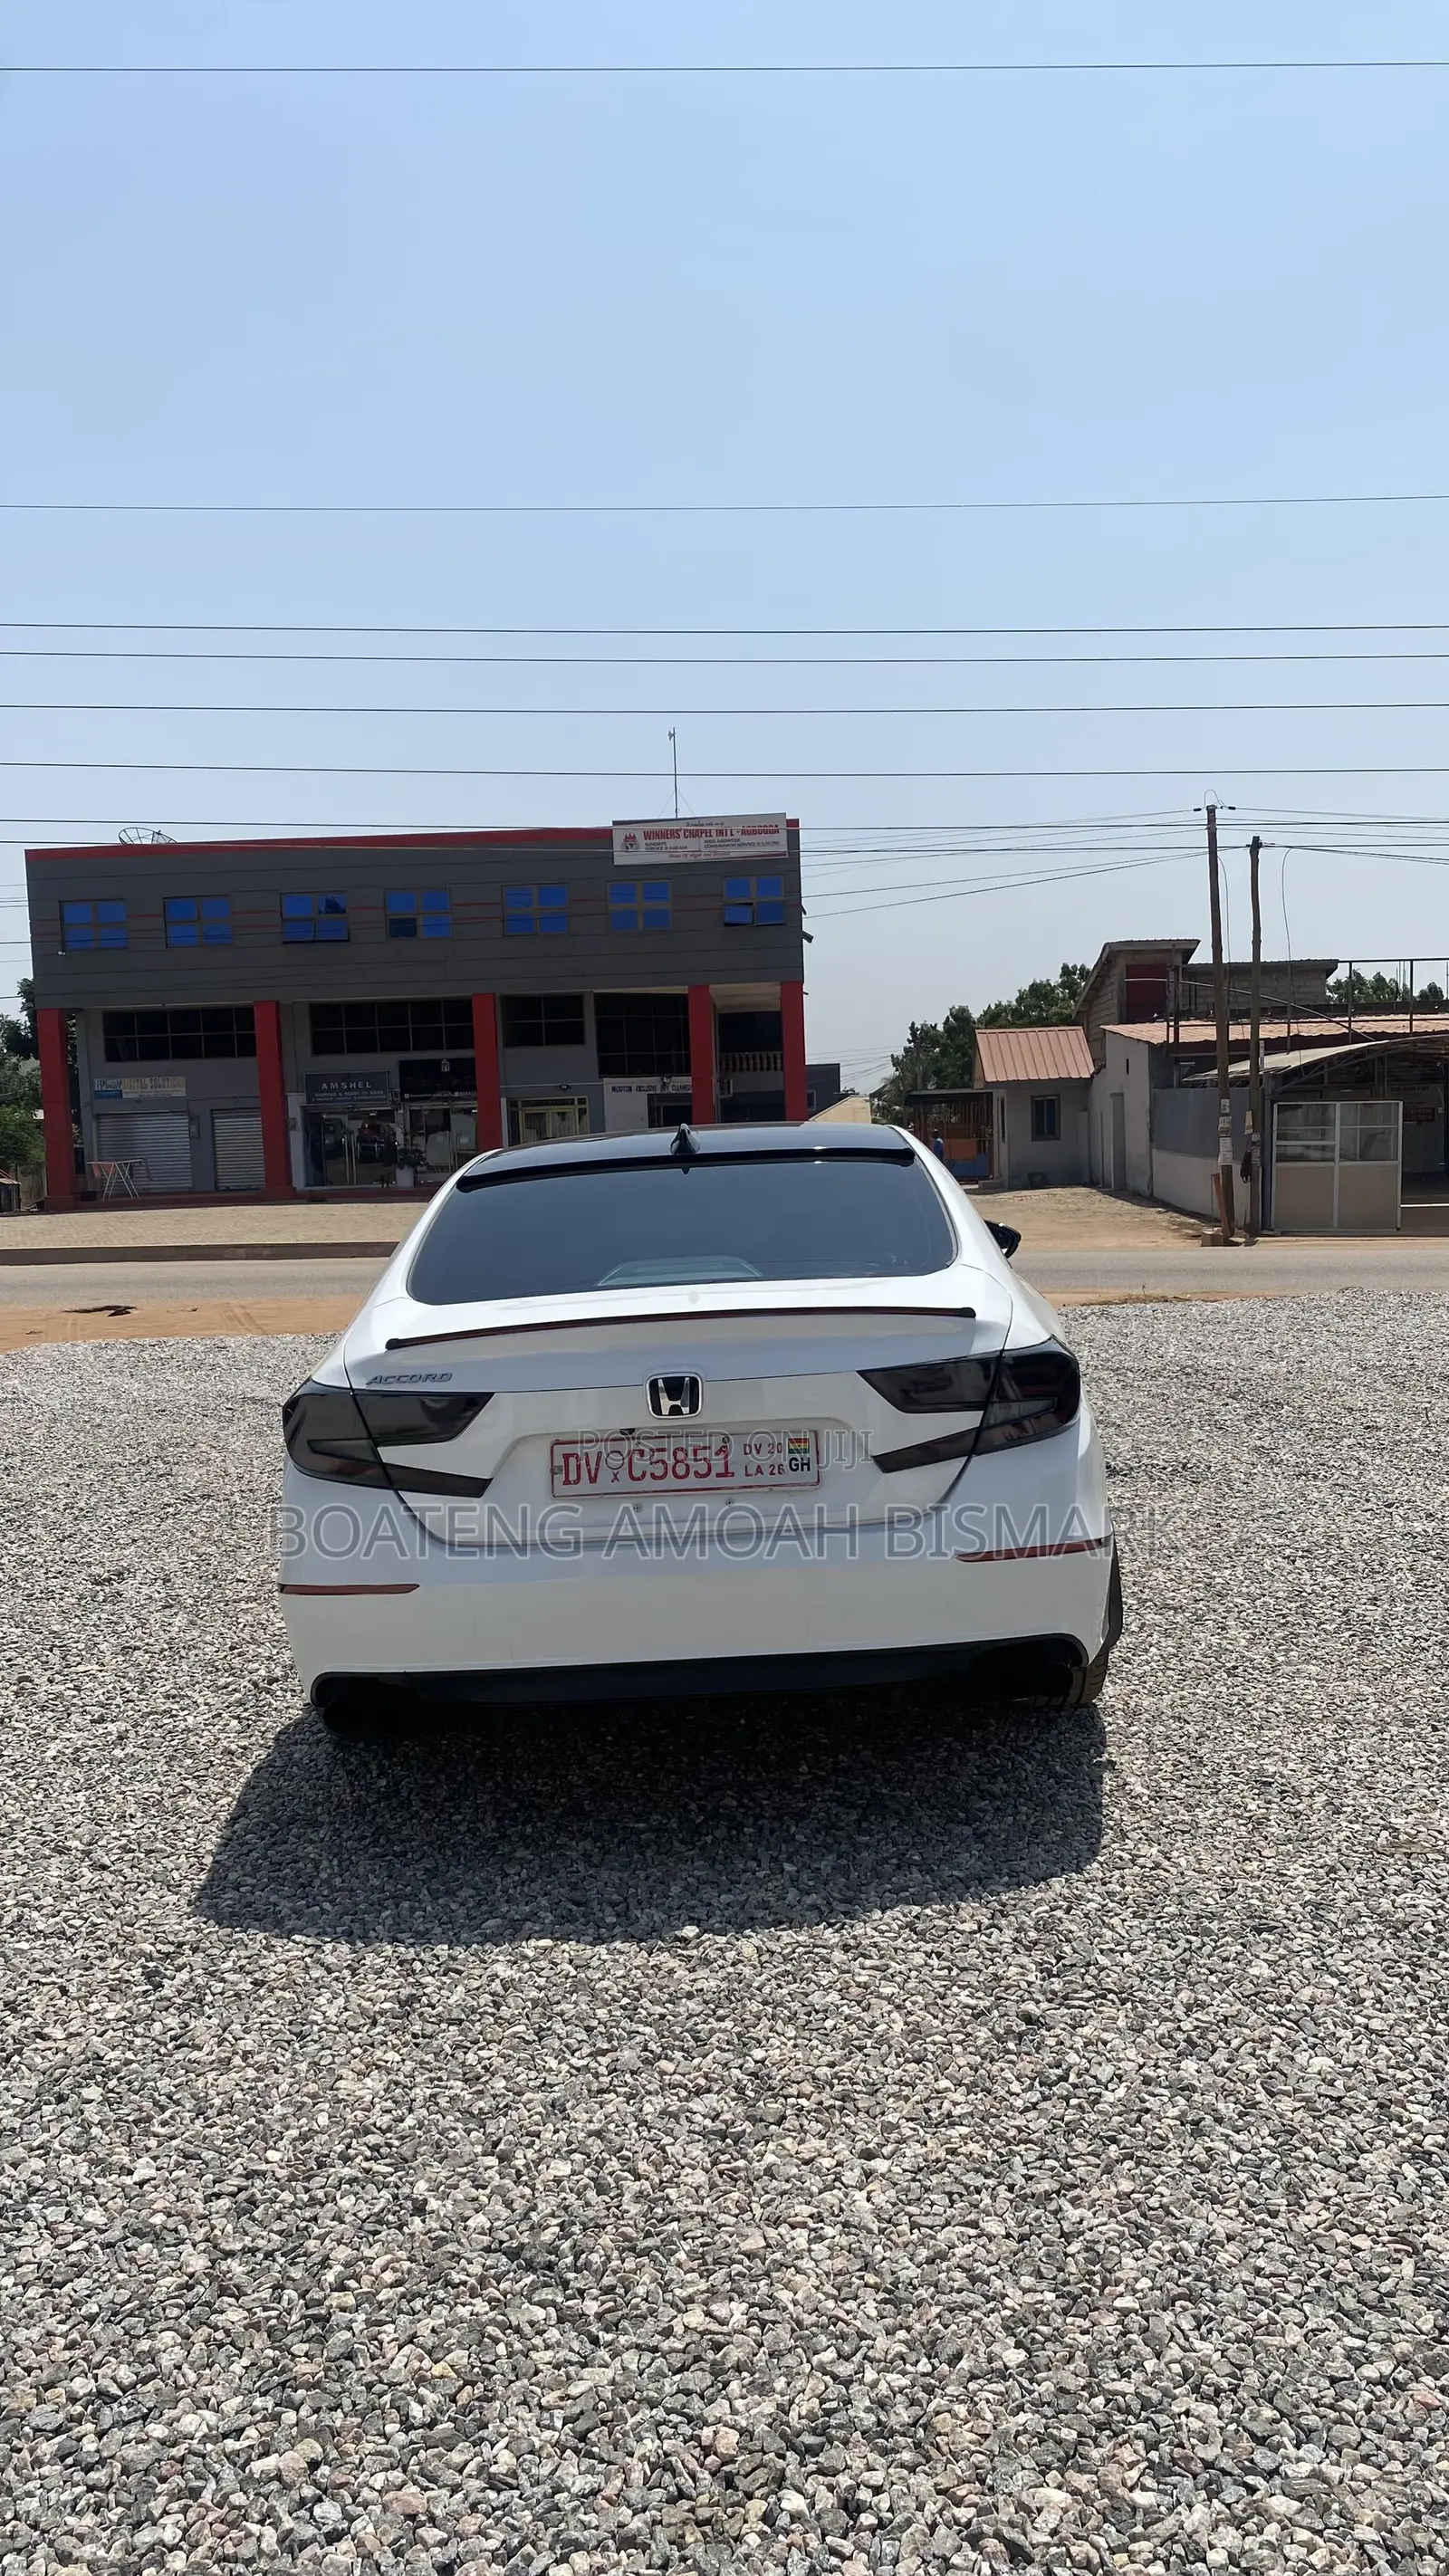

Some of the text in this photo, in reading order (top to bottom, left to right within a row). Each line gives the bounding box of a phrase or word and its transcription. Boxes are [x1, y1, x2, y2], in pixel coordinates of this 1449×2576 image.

[683, 827, 713, 839] CHAPEL
[149, 1077, 185, 1089] SOLUTIONS
[321, 1081, 372, 1090] AMSHEL
[366, 1373, 453, 1385] ACCORD
[743, 1441, 783, 1456] DV 20
[562, 1451, 602, 1486] DV
[628, 1445, 735, 1482] C5851
[744, 1464, 786, 1478] LA 26
[789, 1457, 811, 1472] GH
